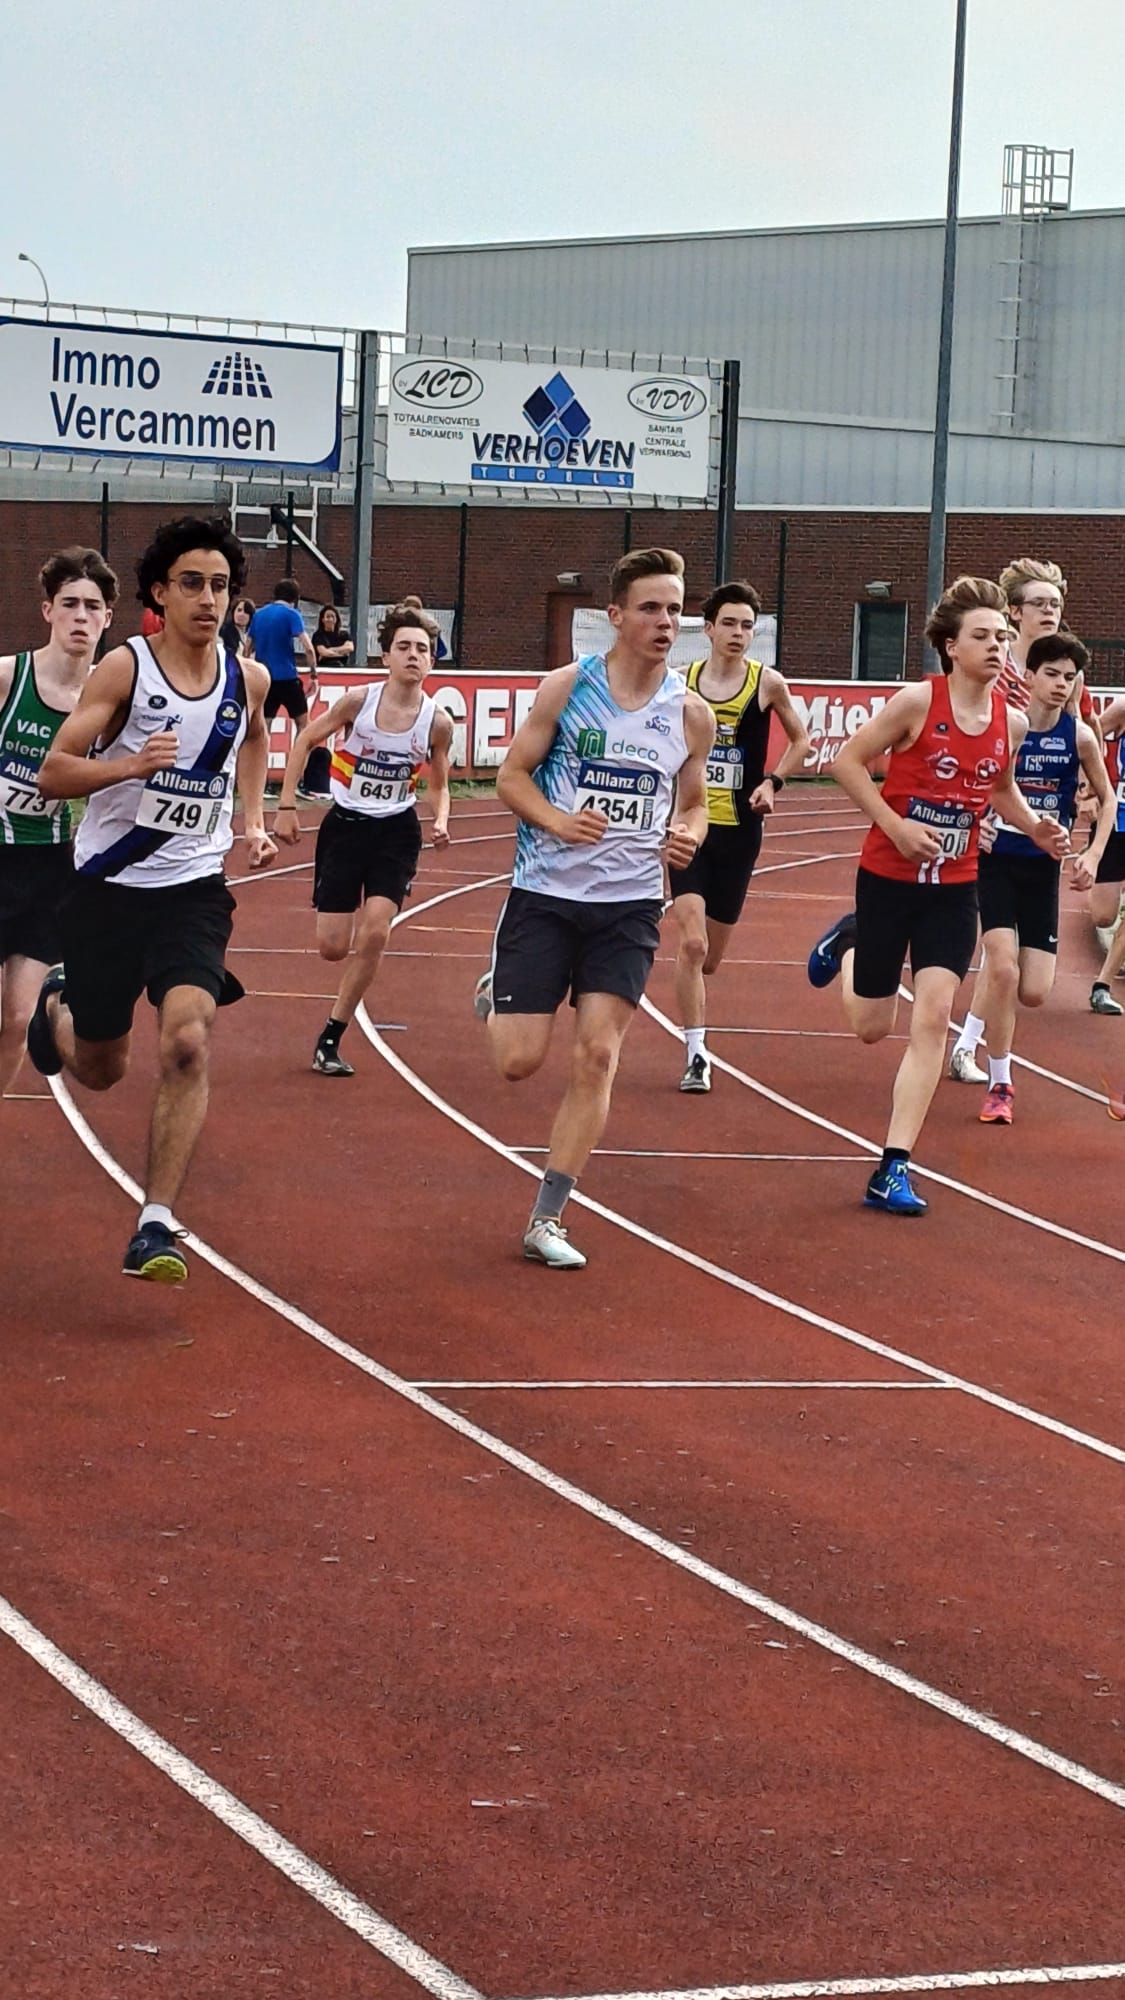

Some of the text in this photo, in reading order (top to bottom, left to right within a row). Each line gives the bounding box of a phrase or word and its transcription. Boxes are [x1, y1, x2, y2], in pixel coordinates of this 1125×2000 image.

[52, 336, 161, 390] Immo
[50, 391, 276, 451] Vercammen
[472, 432, 636, 470] VERHOEVEN
[17, 719, 51, 738] VAC
[5, 740, 46, 758] elect
[612, 739, 659, 761] deco
[4, 761, 40, 783] Allia
[358, 762, 397, 778] Allianz
[583, 769, 635, 789] Allianz
[151, 770, 207, 793] Allianz
[360, 781, 393, 800] 643
[5, 786, 46, 812] 773
[153, 798, 202, 829] 749
[911, 804, 956, 825] Allianz
